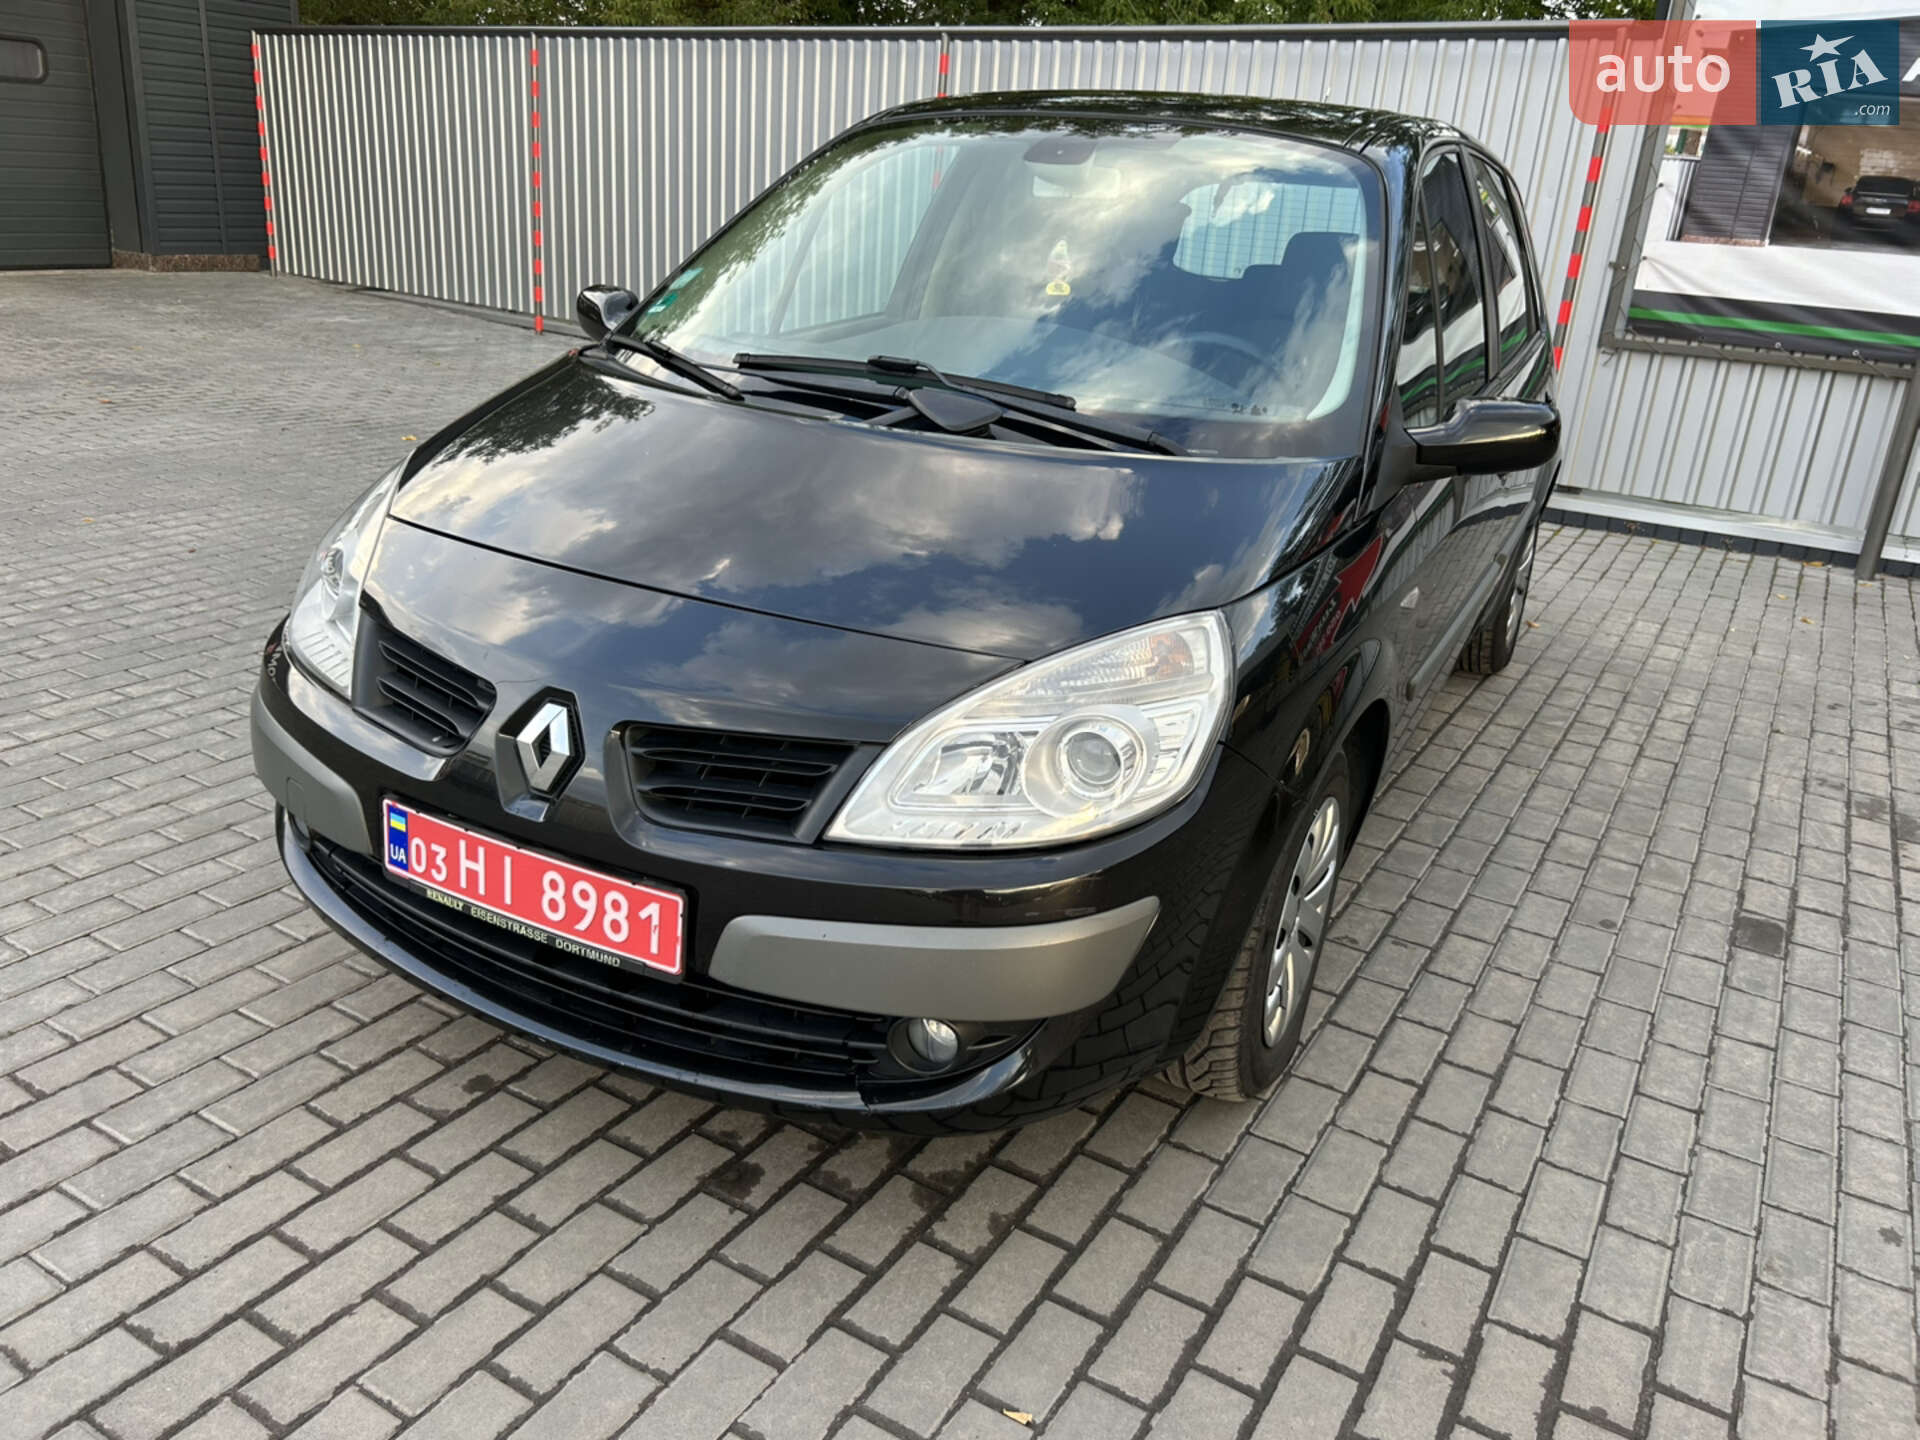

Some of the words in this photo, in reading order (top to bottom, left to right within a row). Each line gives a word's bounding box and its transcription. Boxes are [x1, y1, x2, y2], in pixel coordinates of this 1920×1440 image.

[389, 843, 407, 865] UA
[470, 905, 549, 945] EISENSTRASSE
[555, 937, 621, 968] DORTMUND
[541, 870, 660, 955] 8981
